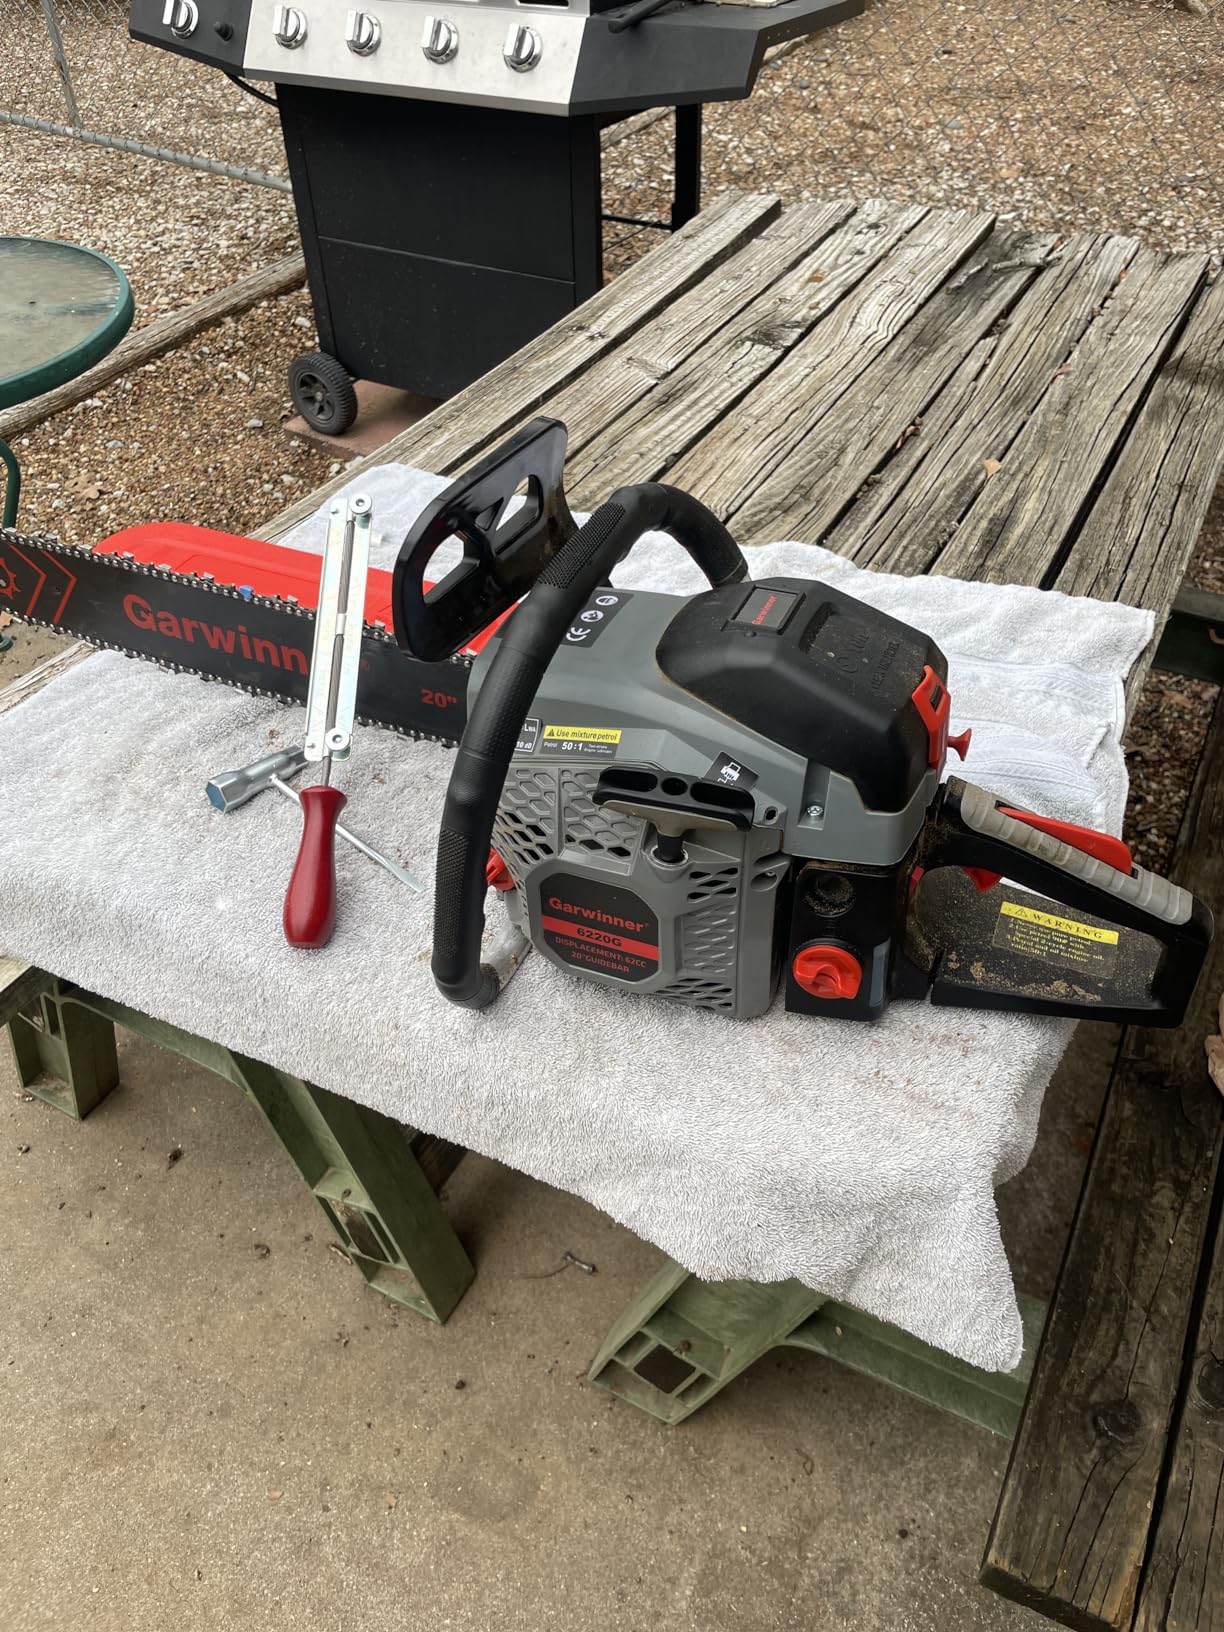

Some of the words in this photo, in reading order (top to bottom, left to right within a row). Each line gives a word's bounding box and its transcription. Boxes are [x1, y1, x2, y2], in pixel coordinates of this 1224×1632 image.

[123, 594, 309, 676] Garwinn
[556, 730, 570, 738] Use
[570, 730, 597, 739] mixture
[597, 733, 618, 741] petrol
[561, 742, 583, 750] 50:1
[549, 897, 644, 932] Garwinner
[1033, 913, 1103, 939] WARNING
[576, 928, 622, 947] 6220G
